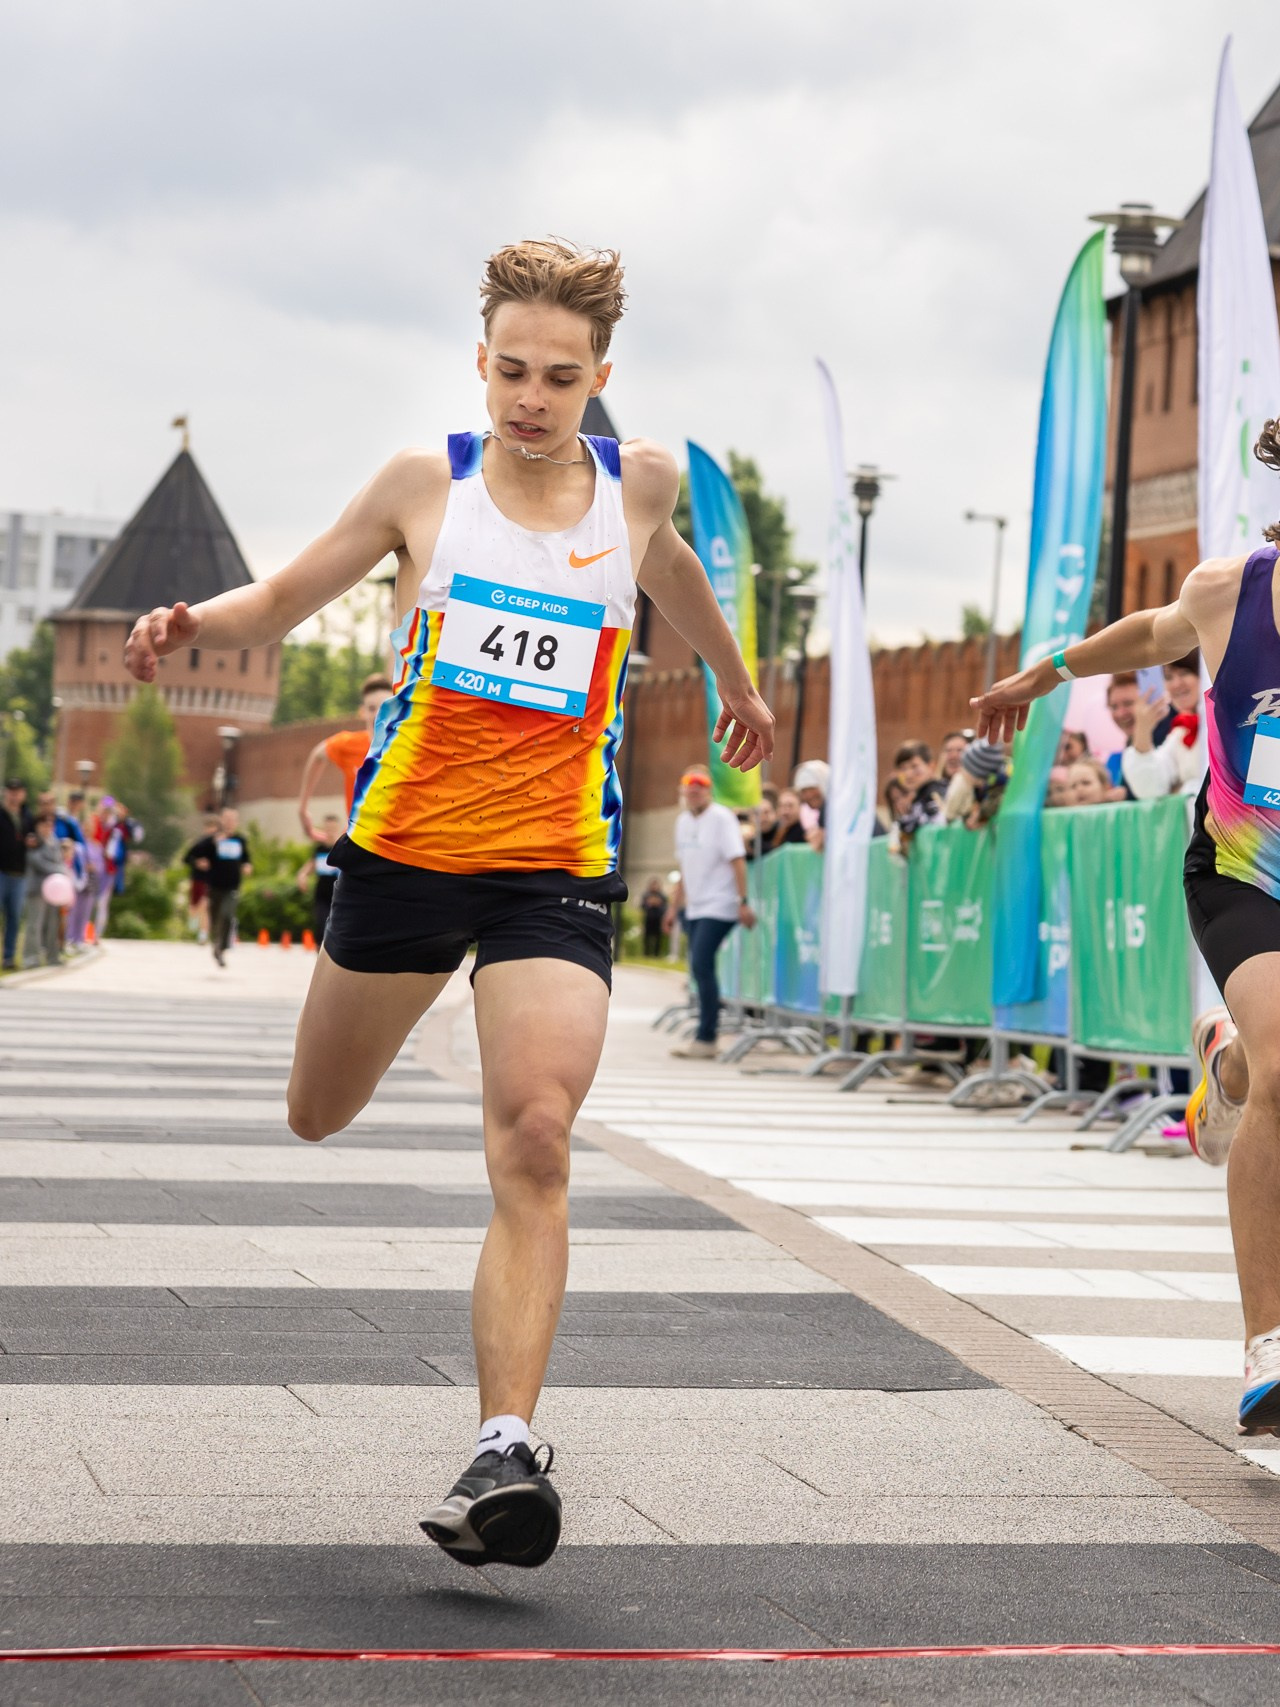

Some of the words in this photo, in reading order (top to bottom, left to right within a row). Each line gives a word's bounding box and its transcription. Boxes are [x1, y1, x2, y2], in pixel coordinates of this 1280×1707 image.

[507, 594, 540, 609] СБЕР
[541, 602, 569, 616] KIDS
[479, 624, 559, 671] 418
[453, 670, 485, 692] 420
